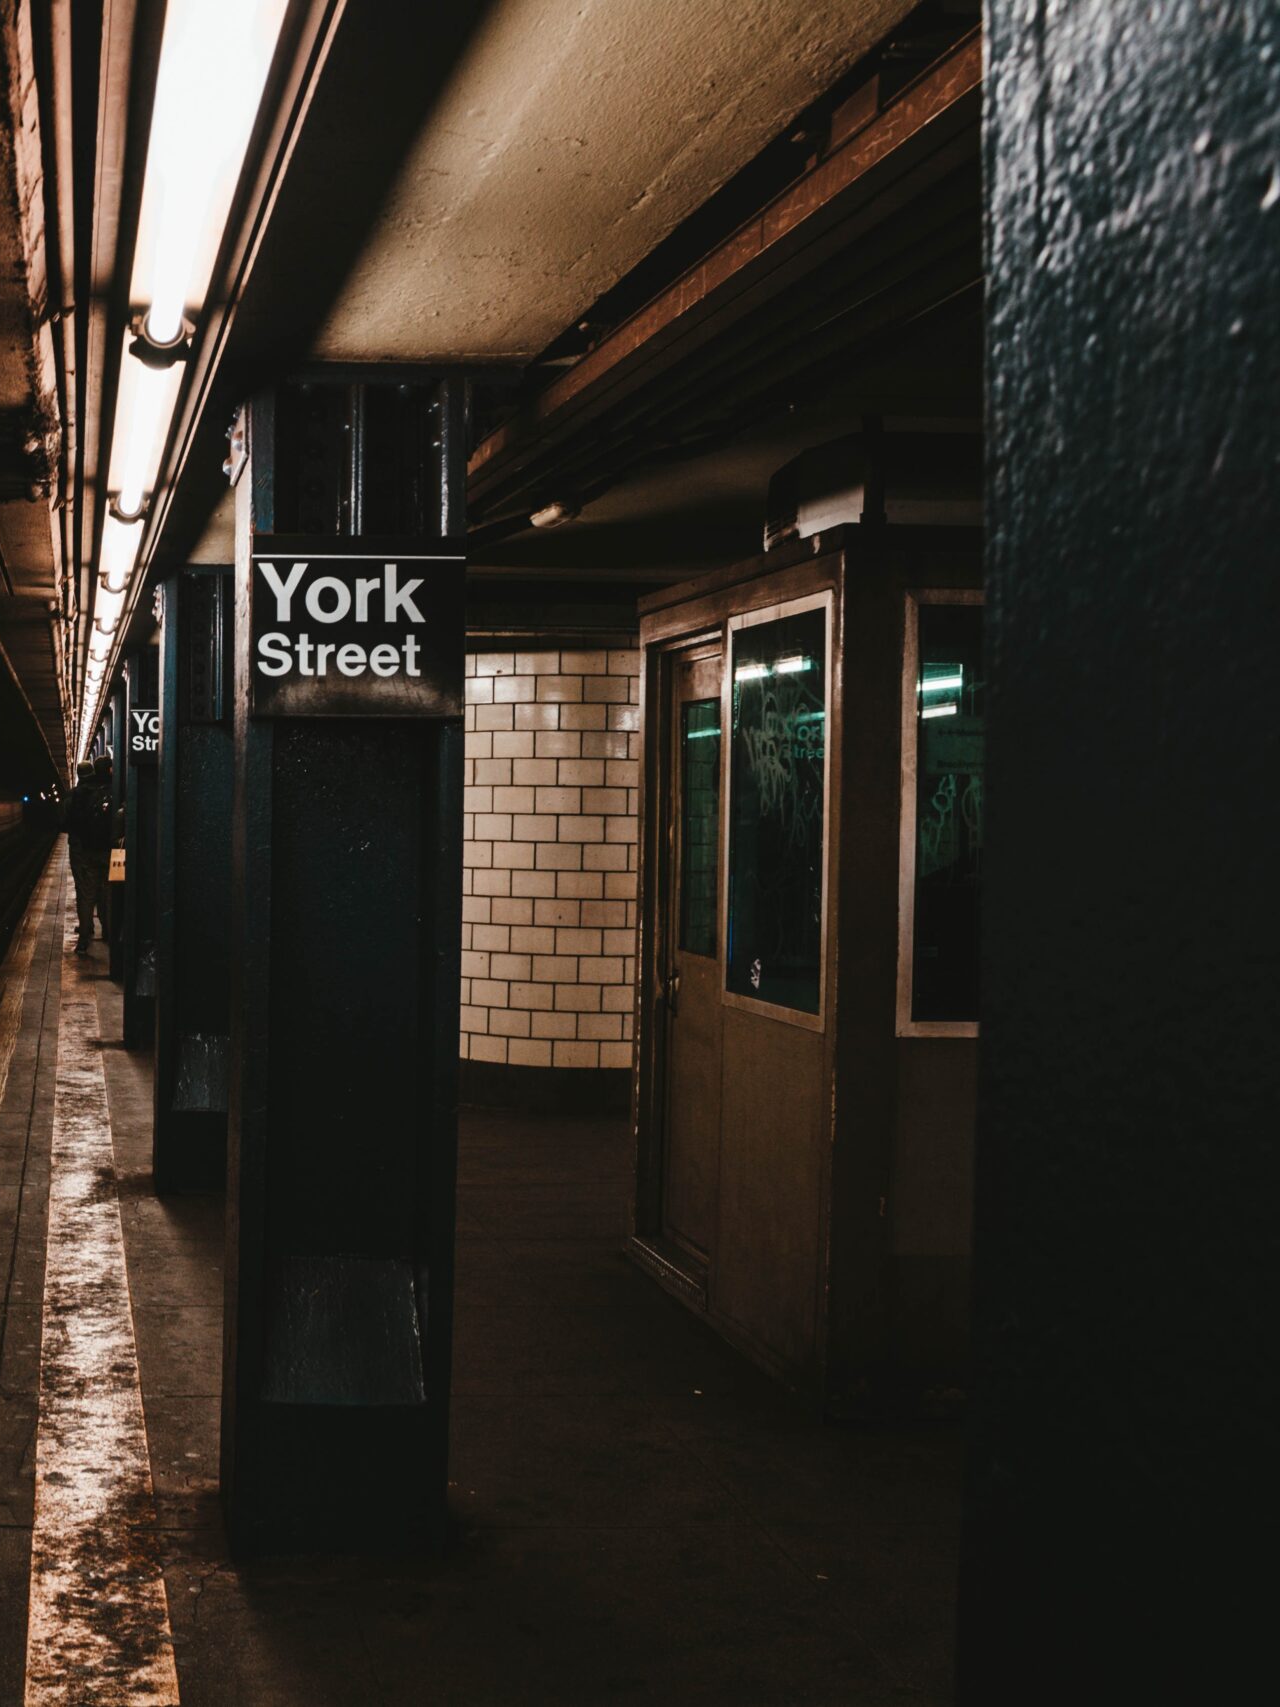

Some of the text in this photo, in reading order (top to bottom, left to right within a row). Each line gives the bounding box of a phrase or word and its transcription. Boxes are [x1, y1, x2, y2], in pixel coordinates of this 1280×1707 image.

[257, 562, 426, 624] York
[257, 632, 421, 678] Street
[132, 712, 160, 734] Yo
[132, 735, 160, 751] Str
